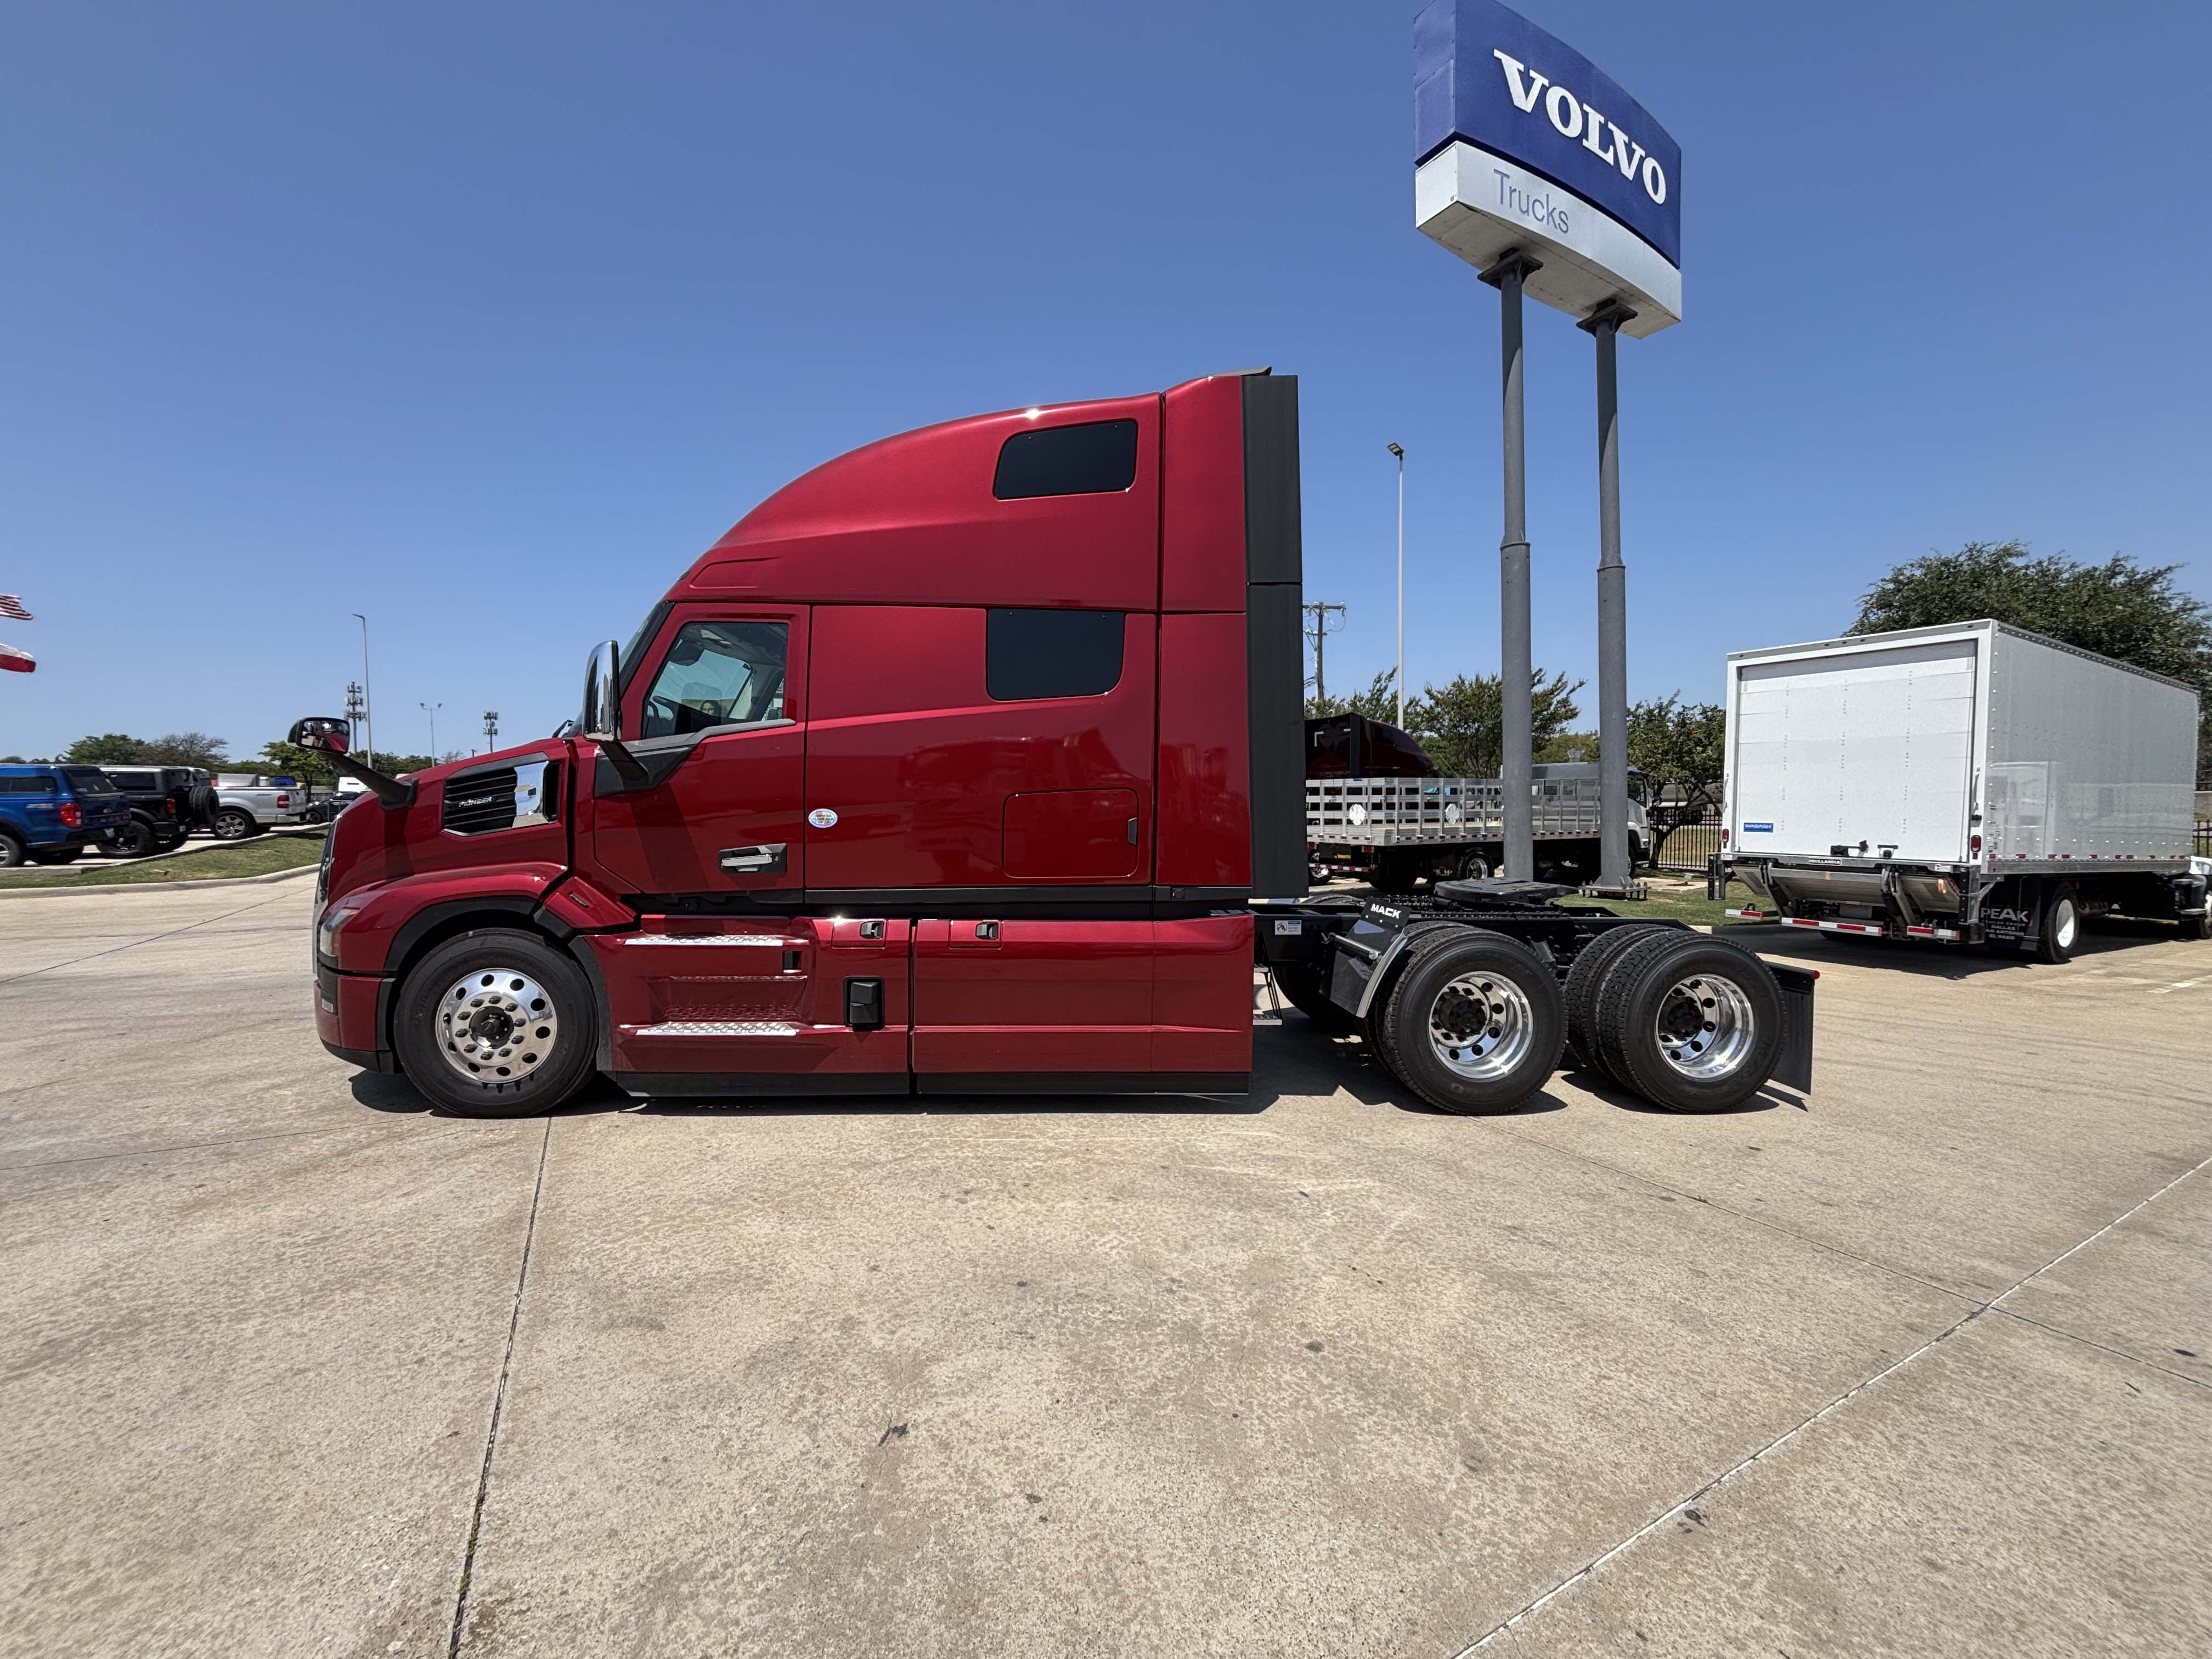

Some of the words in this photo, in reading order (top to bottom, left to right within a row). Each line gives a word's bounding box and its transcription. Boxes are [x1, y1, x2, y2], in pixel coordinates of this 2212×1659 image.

[1493, 48, 1667, 205] VOLVO
[1493, 168, 1570, 234] Trucks
[459, 797, 492, 808] PIONEER
[1370, 903, 1402, 919] MACK
[1980, 907, 2029, 922] PEAK
